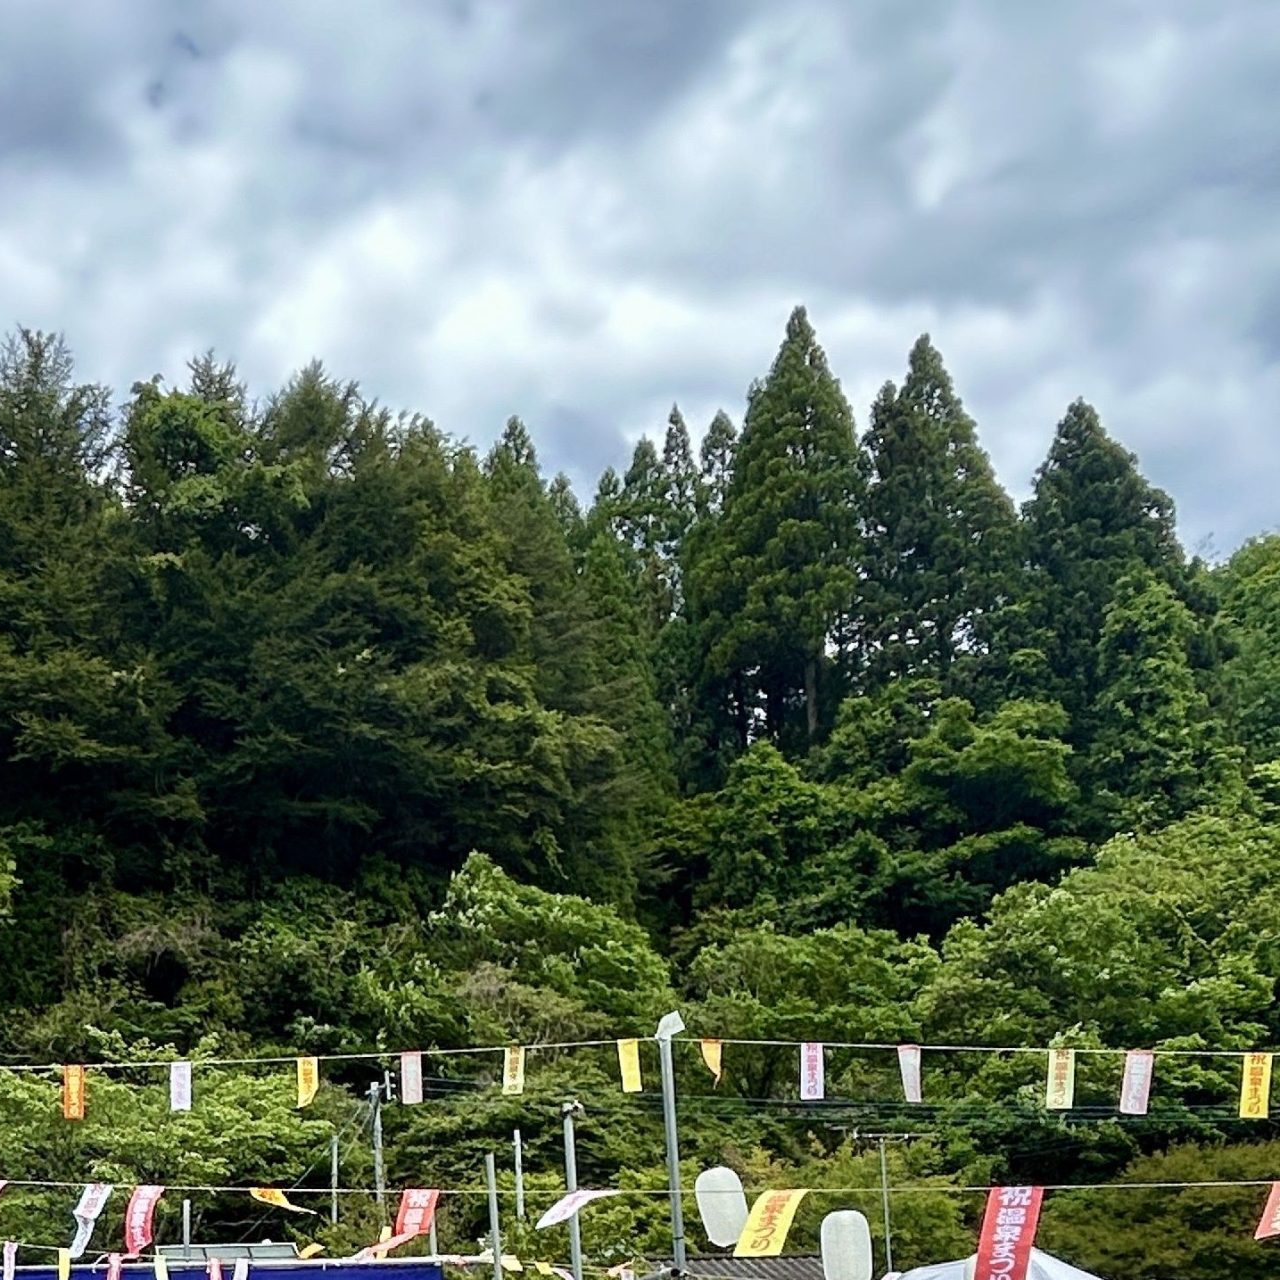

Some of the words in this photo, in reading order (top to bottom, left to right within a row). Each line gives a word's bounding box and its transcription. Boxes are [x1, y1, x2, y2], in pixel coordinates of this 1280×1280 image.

[1250, 1055, 1266, 1114] 祝温泉まつり
